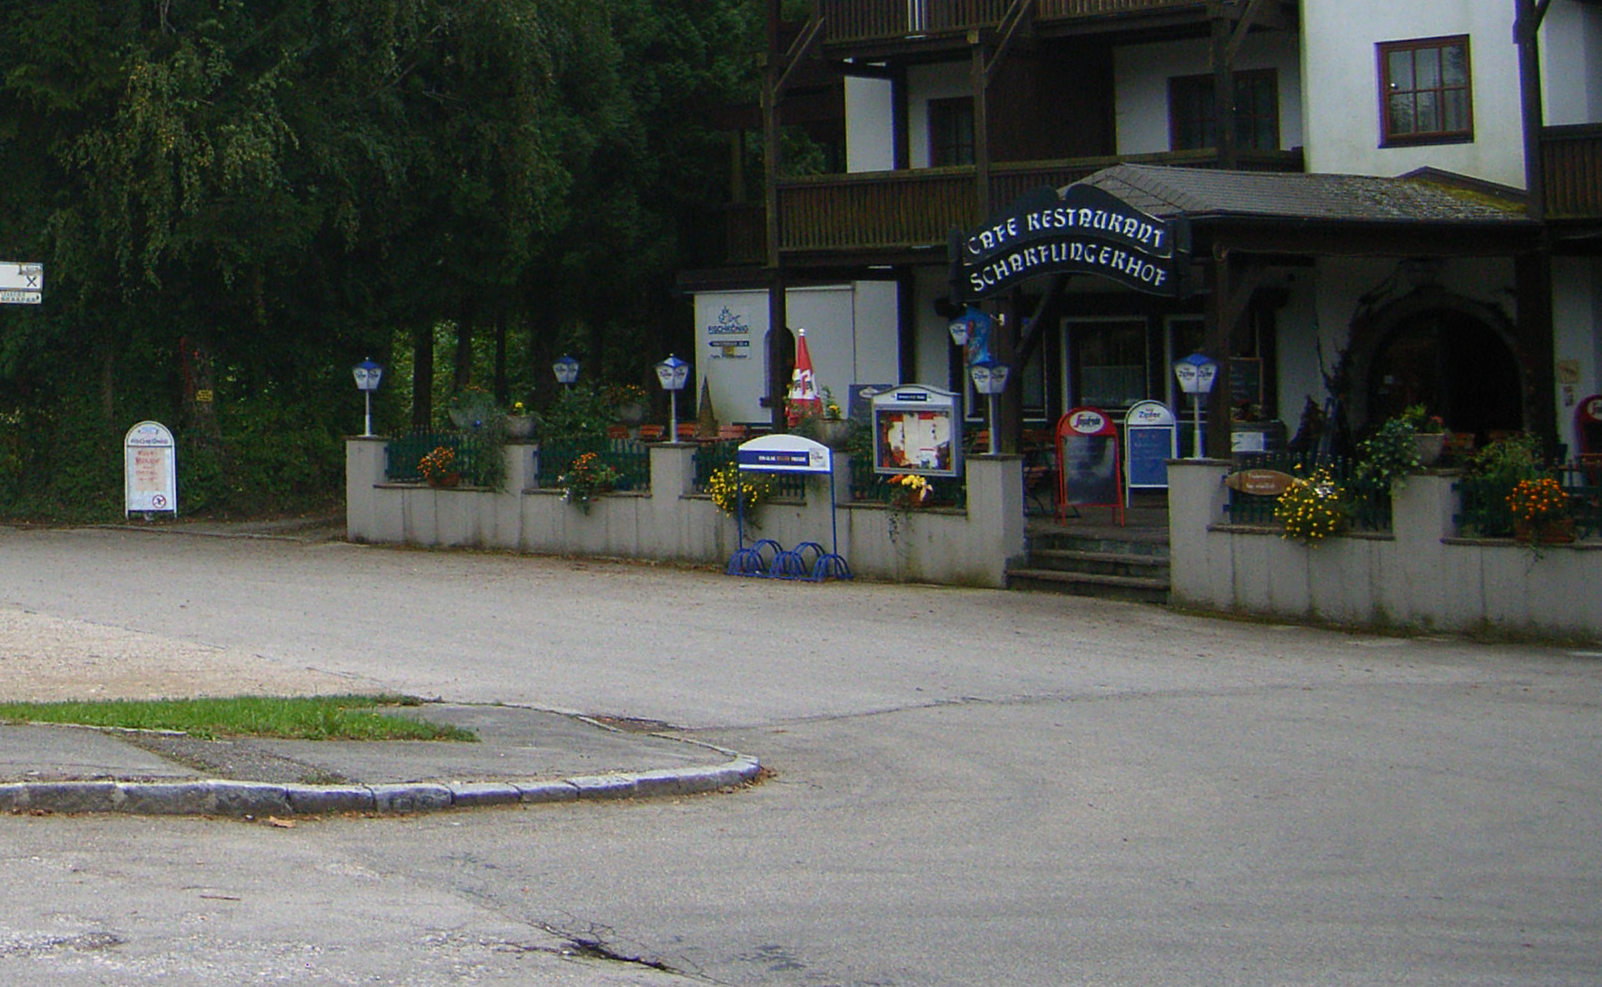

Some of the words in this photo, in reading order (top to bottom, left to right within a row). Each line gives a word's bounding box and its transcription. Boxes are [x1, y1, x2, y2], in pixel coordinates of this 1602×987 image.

[967, 218, 1018, 255] CAFE
[1026, 207, 1165, 248] RESTAURANT
[969, 242, 1168, 292] SCHARFLINGERHOF
